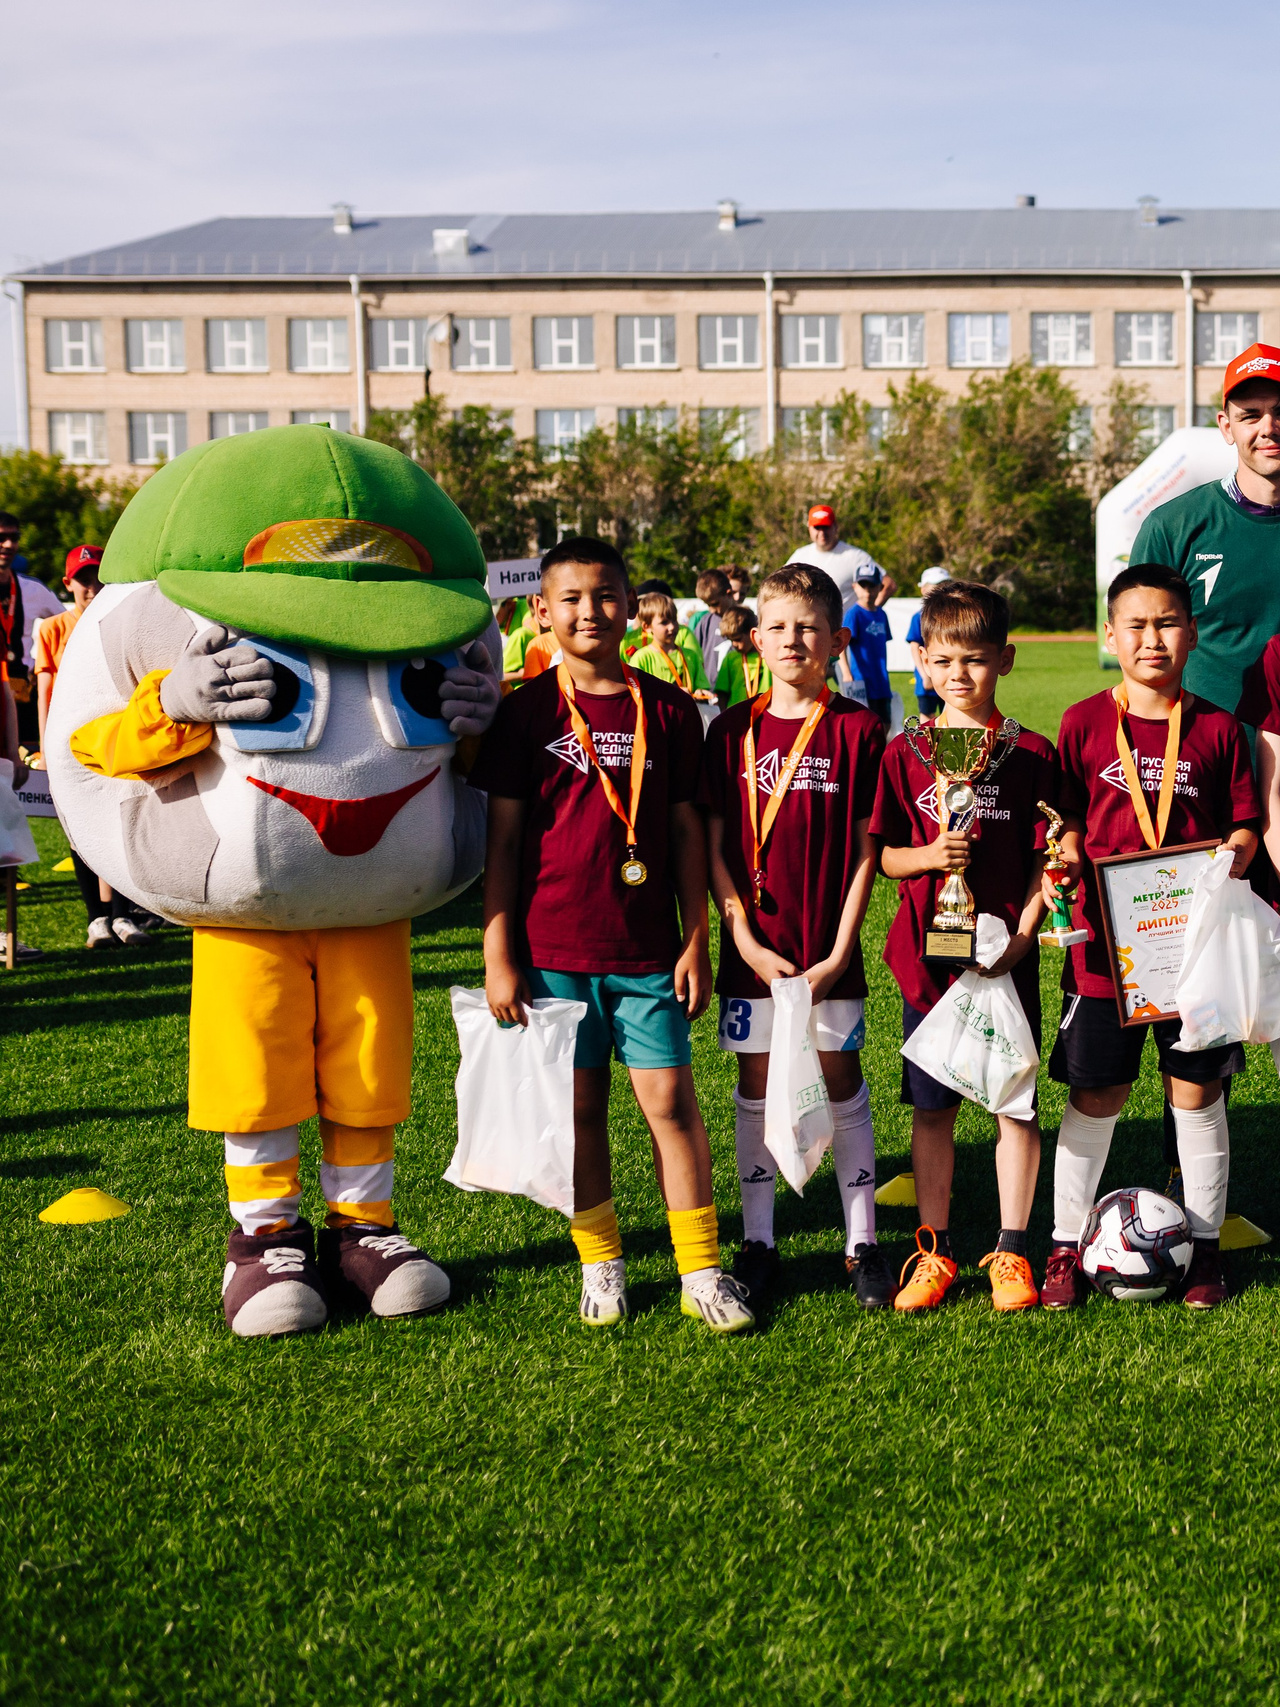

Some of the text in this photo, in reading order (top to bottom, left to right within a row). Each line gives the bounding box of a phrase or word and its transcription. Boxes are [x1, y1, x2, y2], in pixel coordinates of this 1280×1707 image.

[1195, 553, 1224, 562] Первые
[592, 731, 635, 744] РУССКА
[593, 744, 633, 756] МЕДНА
[592, 756, 653, 770] ОМПАЯ
[782, 756, 831, 769] РССКАЯ
[1141, 757, 1191, 772] РУСАЯ
[794, 768, 827, 781] ЕДНАЯ
[1141, 768, 1188, 783] МЕДАЯ
[788, 780, 840, 793] ОМПАНИЯ
[1142, 780, 1199, 797] КОМАНИЯ
[17, 791, 54, 804] пенка
[1151, 897, 1179, 912] 2025
[1136, 914, 1189, 932] ДИПЛО
[1148, 930, 1174, 938] ЛУЧШИЙ
[1155, 943, 1185, 951] НАГРАЖДАЕТ
